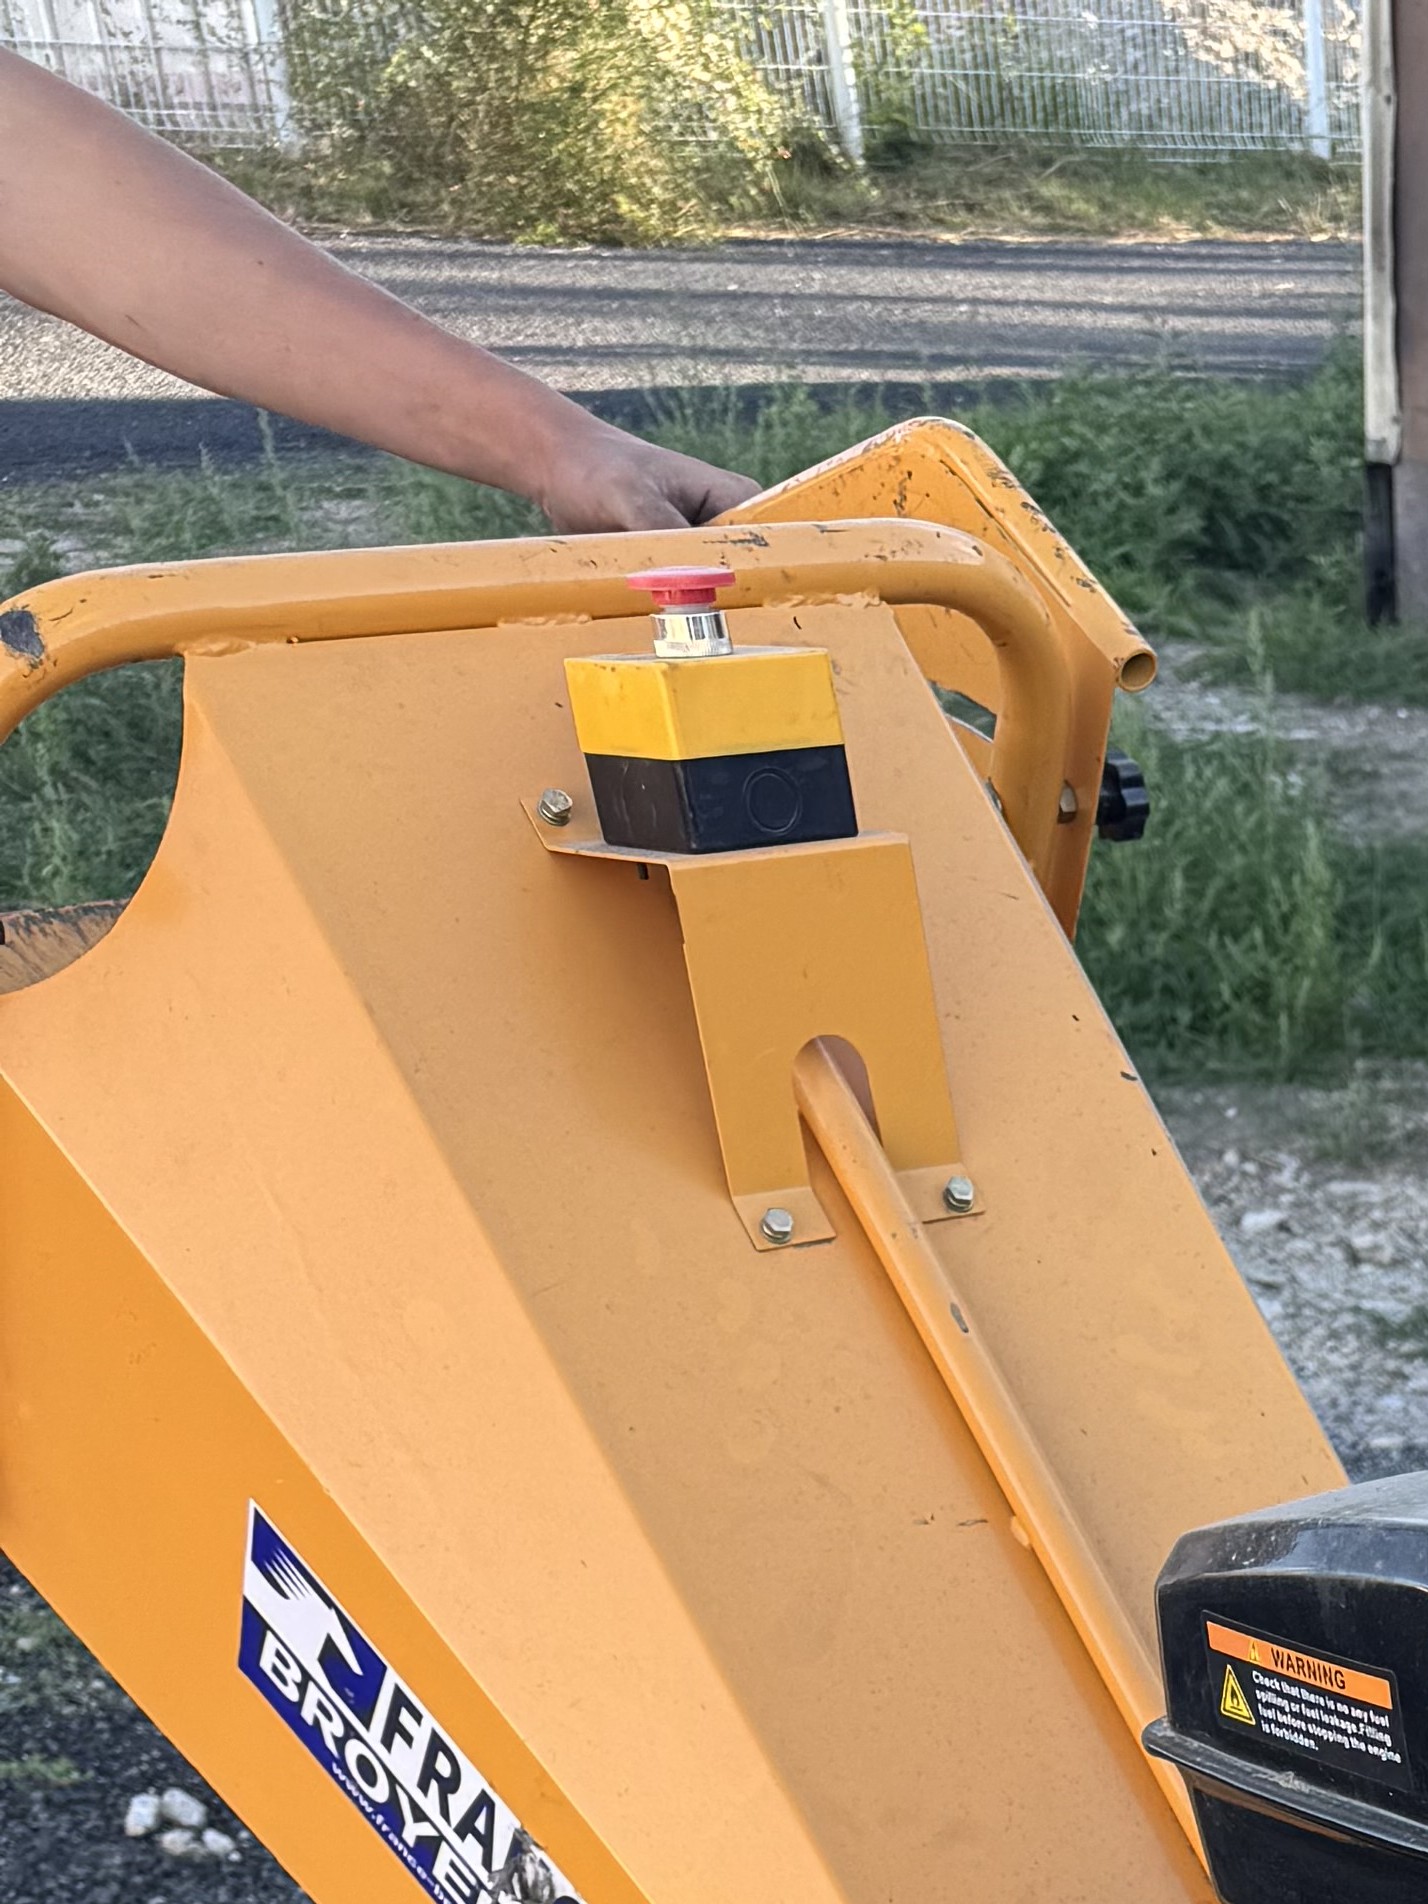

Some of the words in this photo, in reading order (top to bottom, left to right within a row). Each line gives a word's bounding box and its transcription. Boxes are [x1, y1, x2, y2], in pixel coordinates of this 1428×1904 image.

[1270, 1648, 1346, 1690] WARNING
[1252, 1670, 1281, 1691] Check
[1281, 1681, 1301, 1698] that
[1300, 1688, 1325, 1707] there
[1325, 1696, 1335, 1710] is
[1336, 1702, 1349, 1715] no
[1350, 1707, 1368, 1723] any
[1369, 1710, 1390, 1728] fuel
[1255, 1689, 1290, 1712] spilling
[1290, 1701, 1300, 1713] or
[1301, 1703, 1320, 1720] fuel
[1258, 1703, 1276, 1720] fuel
[1276, 1709, 1307, 1731] before
[1307, 1723, 1350, 1749] stopping
[1350, 1736, 1366, 1752] the
[1367, 1744, 1402, 1764] engine
[1261, 1720, 1271, 1734] is
[1270, 1723, 1319, 1751] forbidden.
